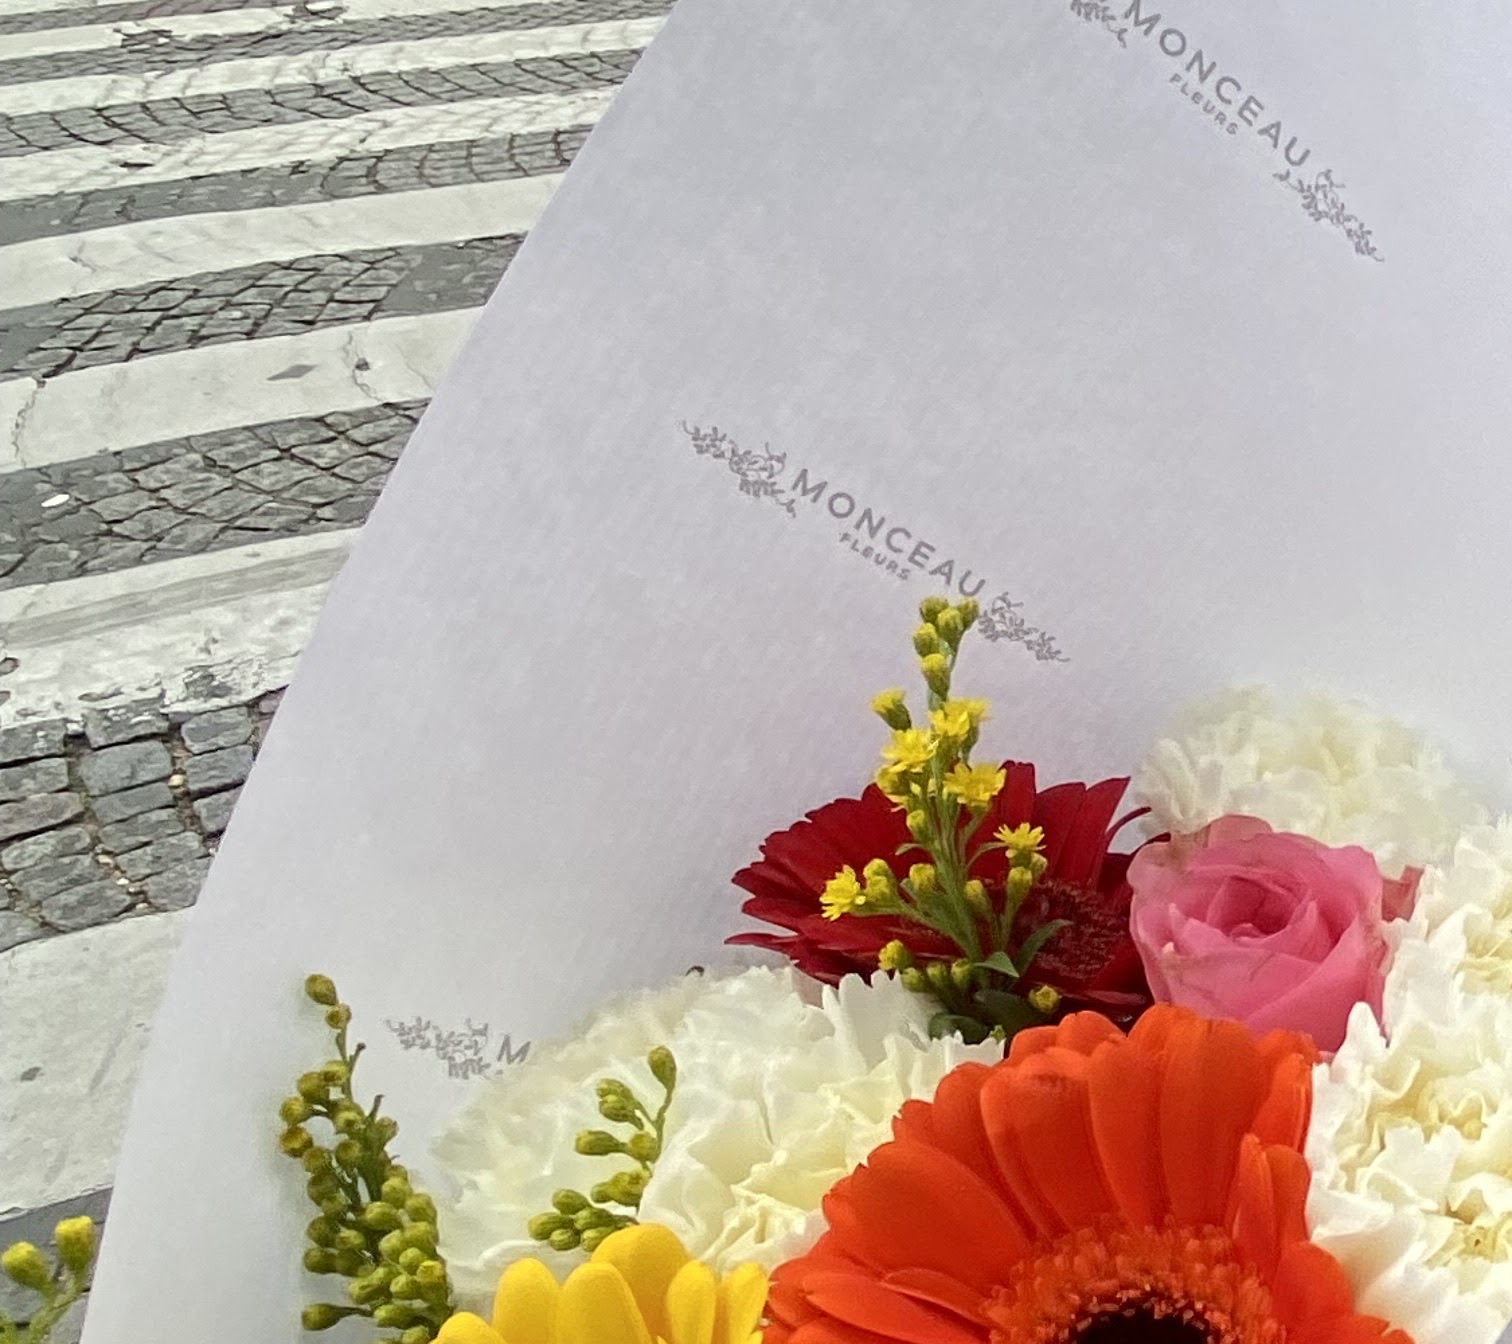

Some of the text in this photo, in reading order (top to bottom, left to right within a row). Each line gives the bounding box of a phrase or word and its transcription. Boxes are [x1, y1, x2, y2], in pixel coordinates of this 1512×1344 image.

[1168, 73, 1239, 135] FLEURS
[790, 468, 986, 597] MONCEAU
[839, 531, 911, 581] FLEURS
